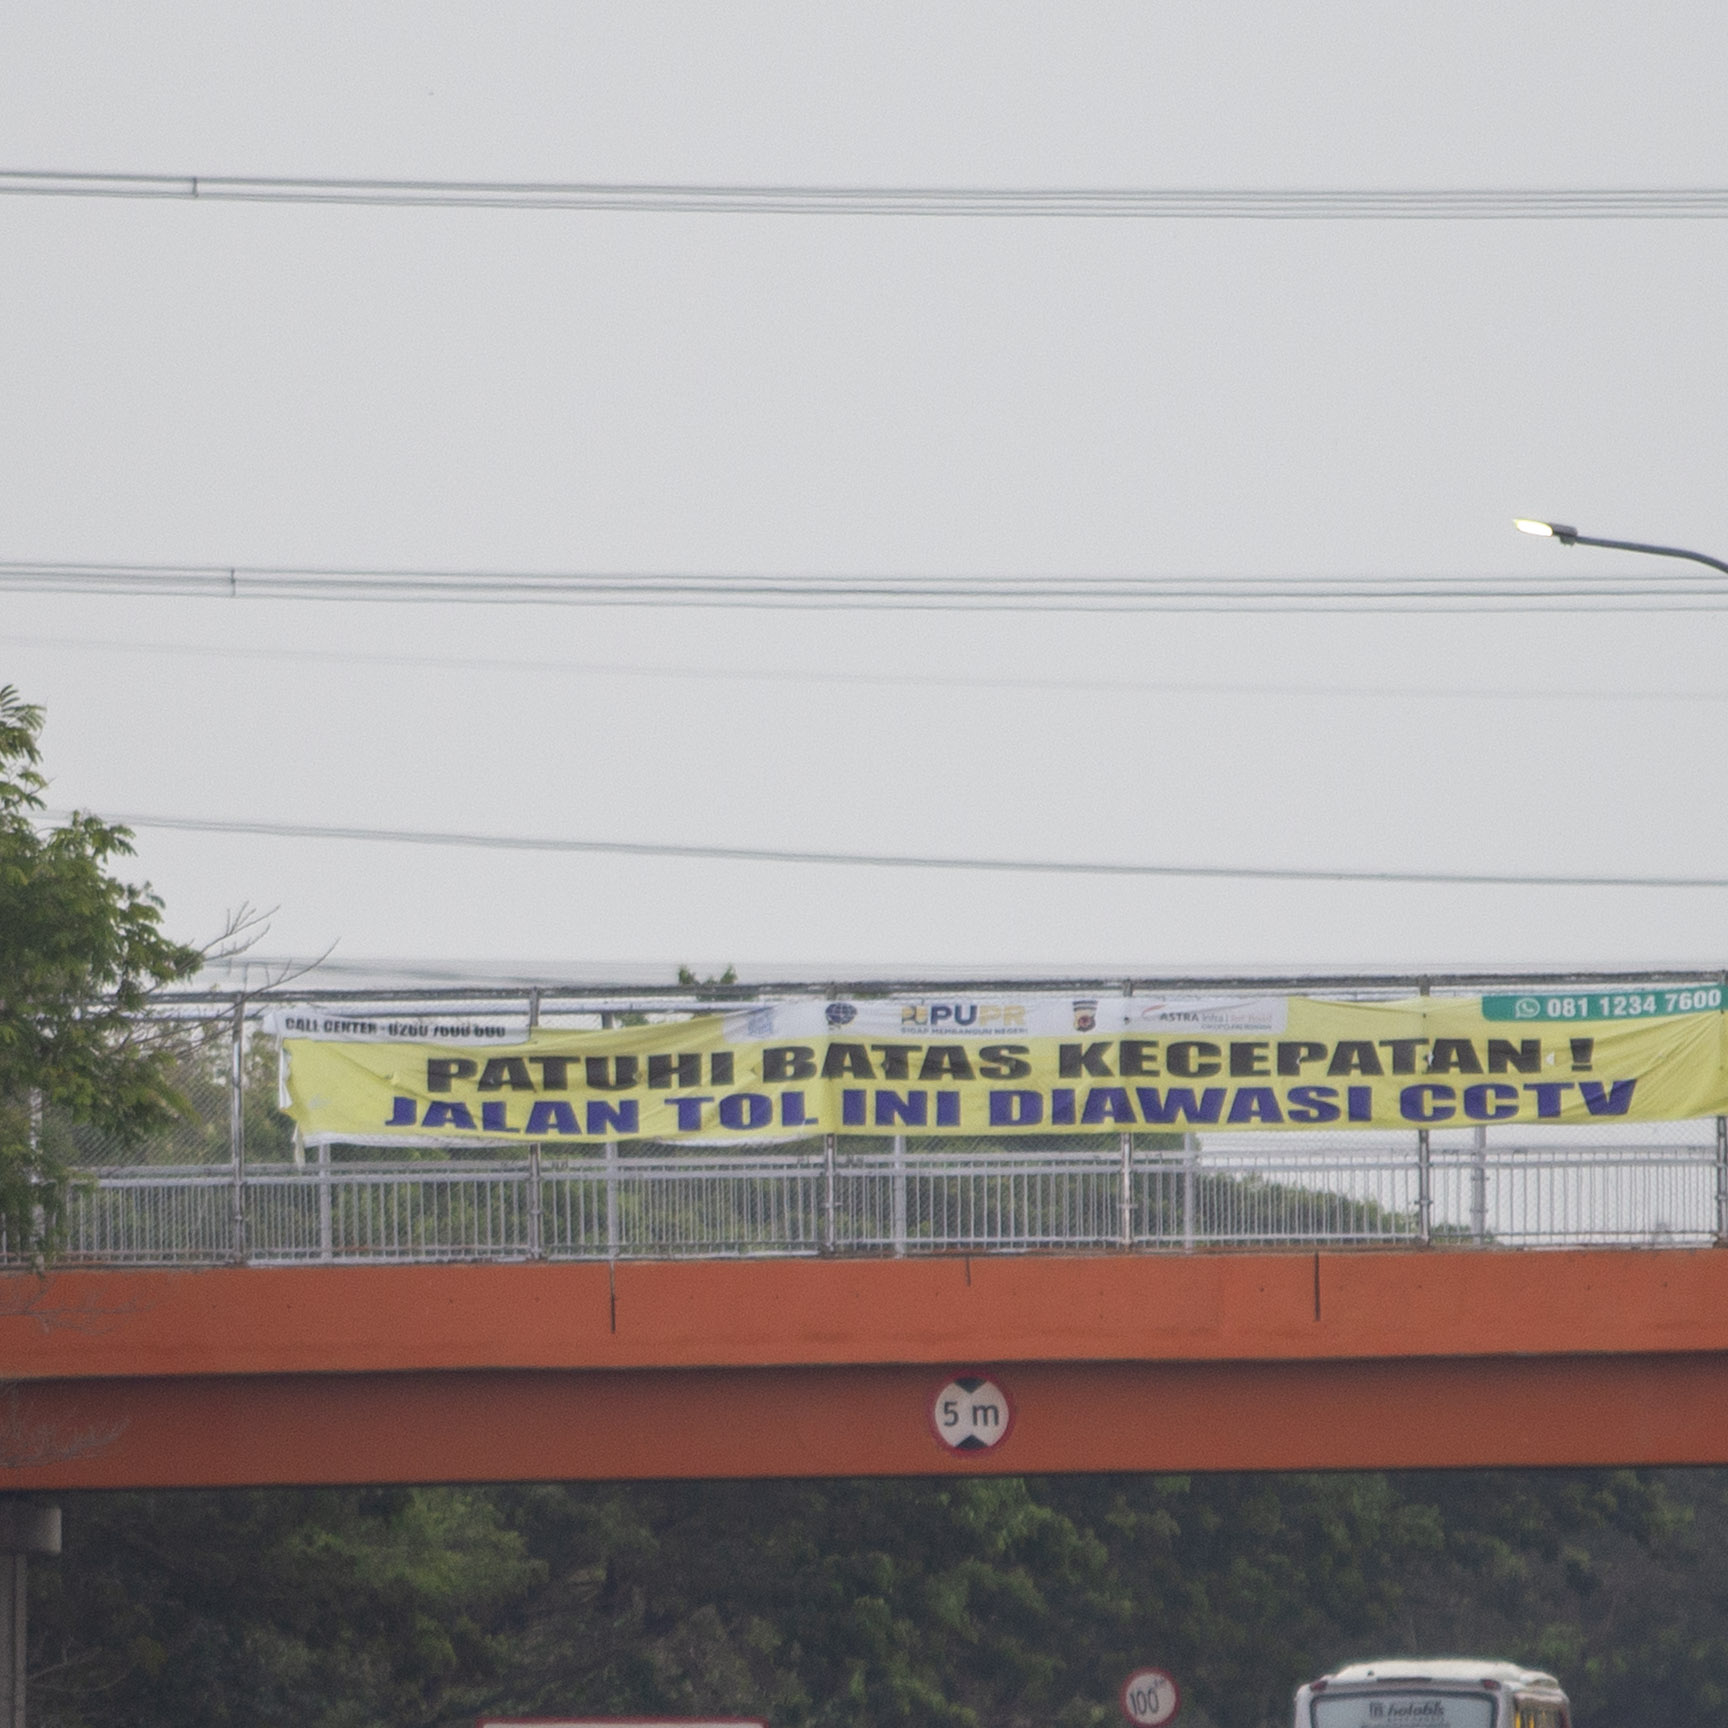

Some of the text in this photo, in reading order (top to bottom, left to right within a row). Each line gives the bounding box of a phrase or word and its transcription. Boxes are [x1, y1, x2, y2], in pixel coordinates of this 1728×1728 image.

[929, 1004, 1027, 1026] PUPR
[1546, 988, 1721, 1018] 081 1234 7600
[285, 1018, 319, 1033] CALL
[323, 1019, 377, 1034] CENTER
[1160, 1012, 1200, 1023] ASTRA
[427, 1037, 1594, 1094] PATUHI BATAS KECEPATAN !
[385, 1078, 1638, 1135] JALAN TOL INI DIAWASI CCTV
[943, 1401, 1000, 1427] 5 m
[1129, 1687, 1160, 1714] 100
